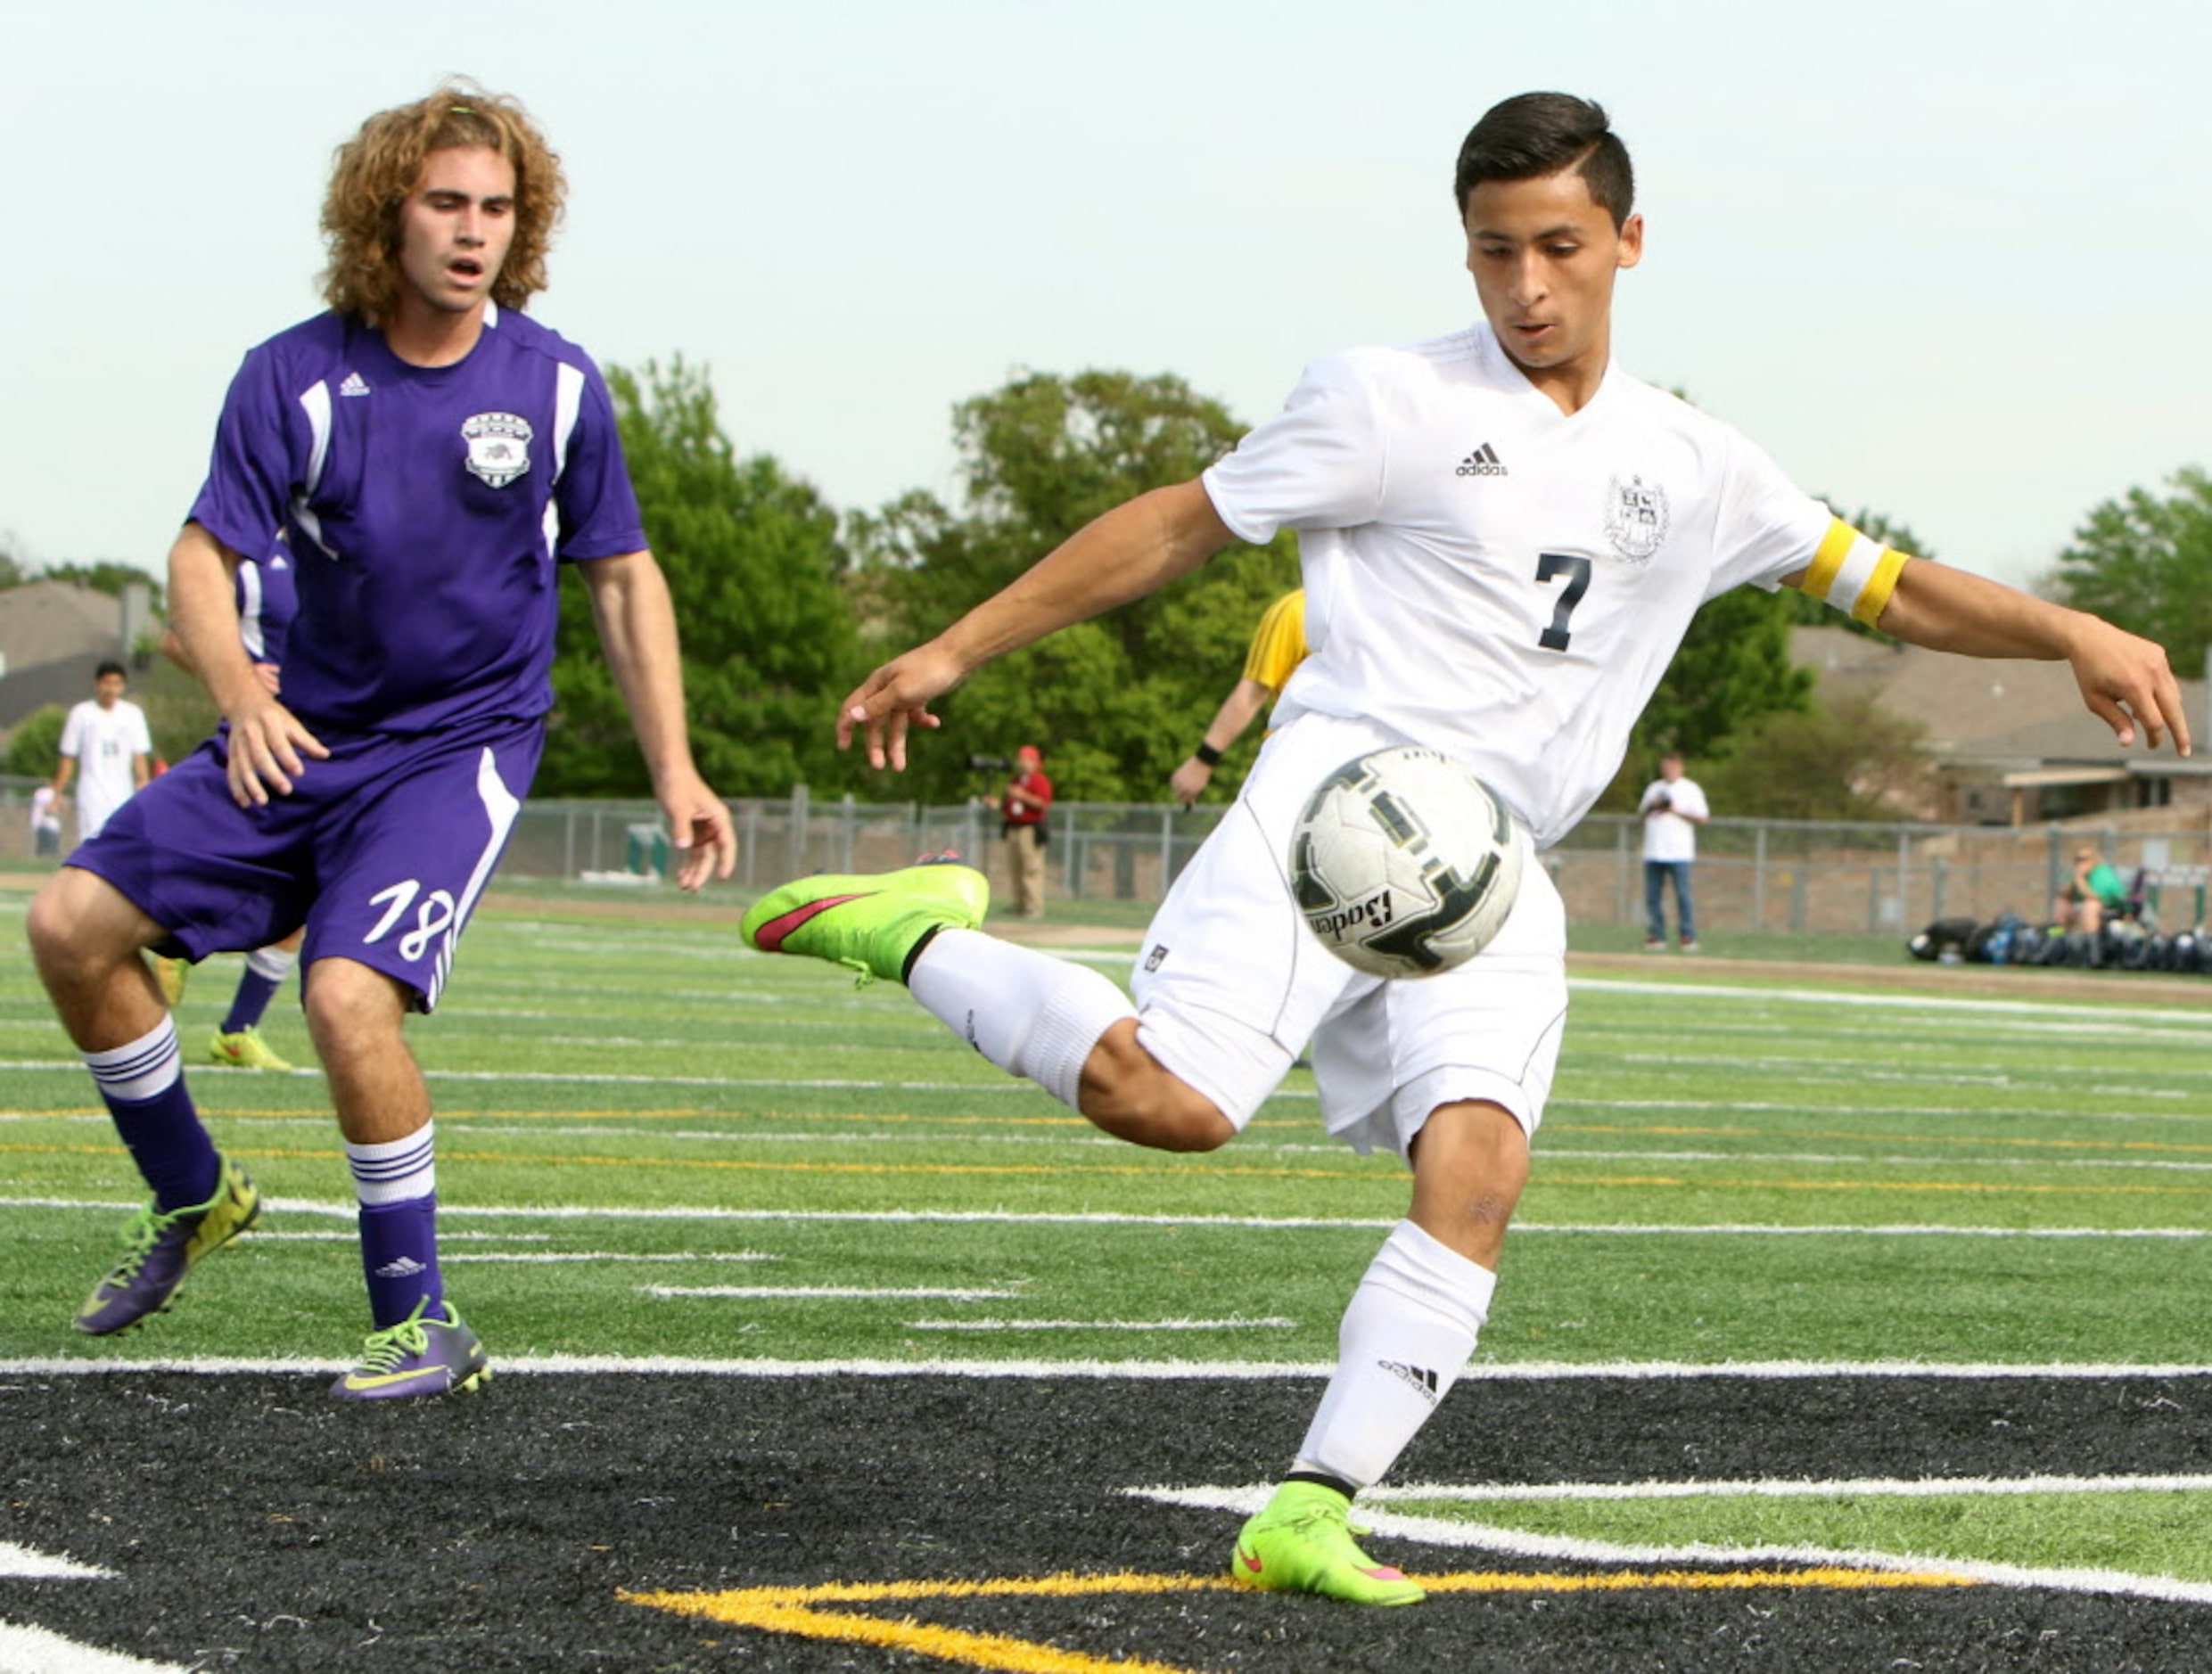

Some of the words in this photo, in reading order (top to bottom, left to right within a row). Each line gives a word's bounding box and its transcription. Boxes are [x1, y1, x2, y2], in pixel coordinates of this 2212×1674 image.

[1455, 464, 1509, 477] adidas
[1535, 553, 1591, 652] 7
[362, 878, 456, 963] 18
[1309, 890, 1393, 942] Baden
